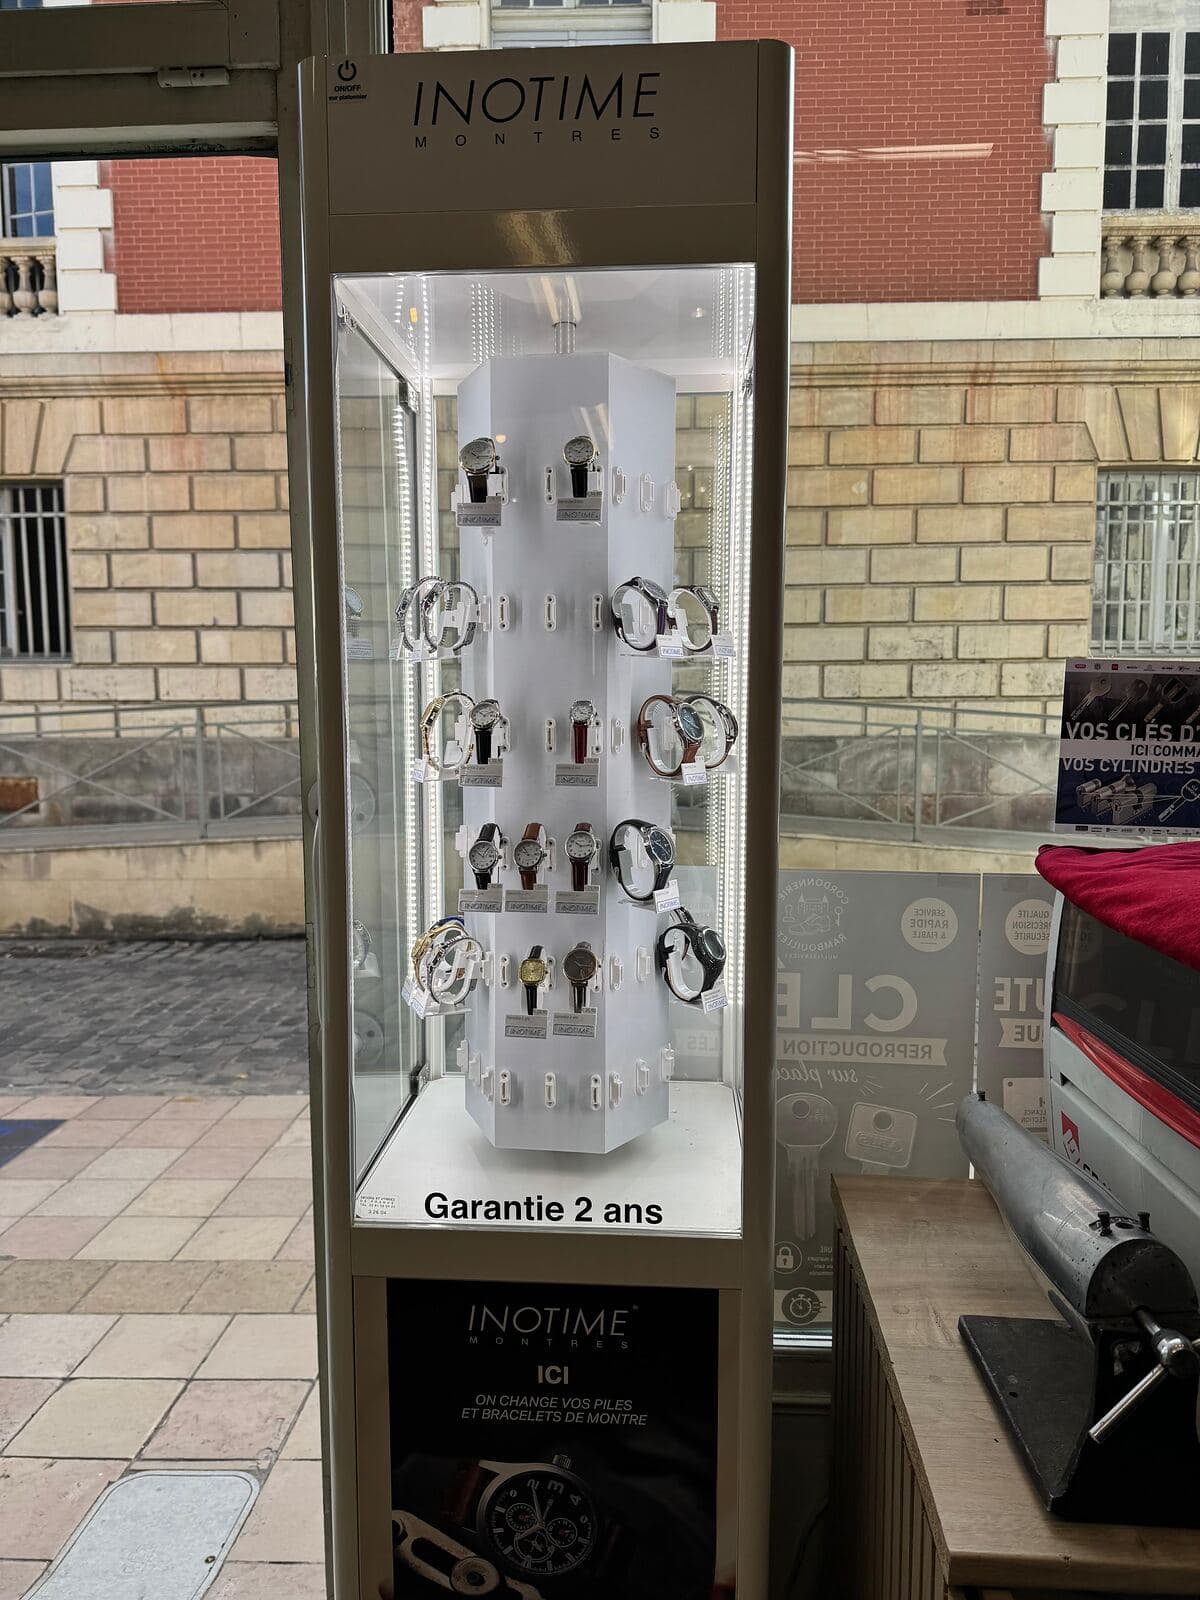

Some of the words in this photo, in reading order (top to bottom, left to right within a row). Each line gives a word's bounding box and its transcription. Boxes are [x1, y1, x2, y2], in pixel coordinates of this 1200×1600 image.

[334, 84, 361, 92] ON/OFF
[413, 72, 661, 126] INOTIME
[414, 127, 661, 148] MONTRES
[1066, 721, 1109, 740] VOS
[1115, 718, 1173, 742] CLÉS
[1131, 744, 1149, 756] ICI
[1063, 757, 1095, 771] VOS
[1100, 758, 1195, 774] CYLINDRES
[424, 1192, 565, 1221] Garantie
[575, 1196, 593, 1222] 2
[603, 1203, 663, 1224] ans
[469, 1304, 629, 1336] INOTIME
[469, 1336, 628, 1349] MONTRES
[538, 1365, 568, 1384] ICI
[475, 1394, 497, 1406] ON
[500, 1396, 559, 1408] CHANGE
[562, 1398, 591, 1410] VOS
[594, 1399, 633, 1411] PILES
[461, 1407, 480, 1419] ET
[482, 1408, 562, 1422] BRACELETS
[565, 1411, 585, 1423] DE
[587, 1412, 648, 1426] MONTRE
